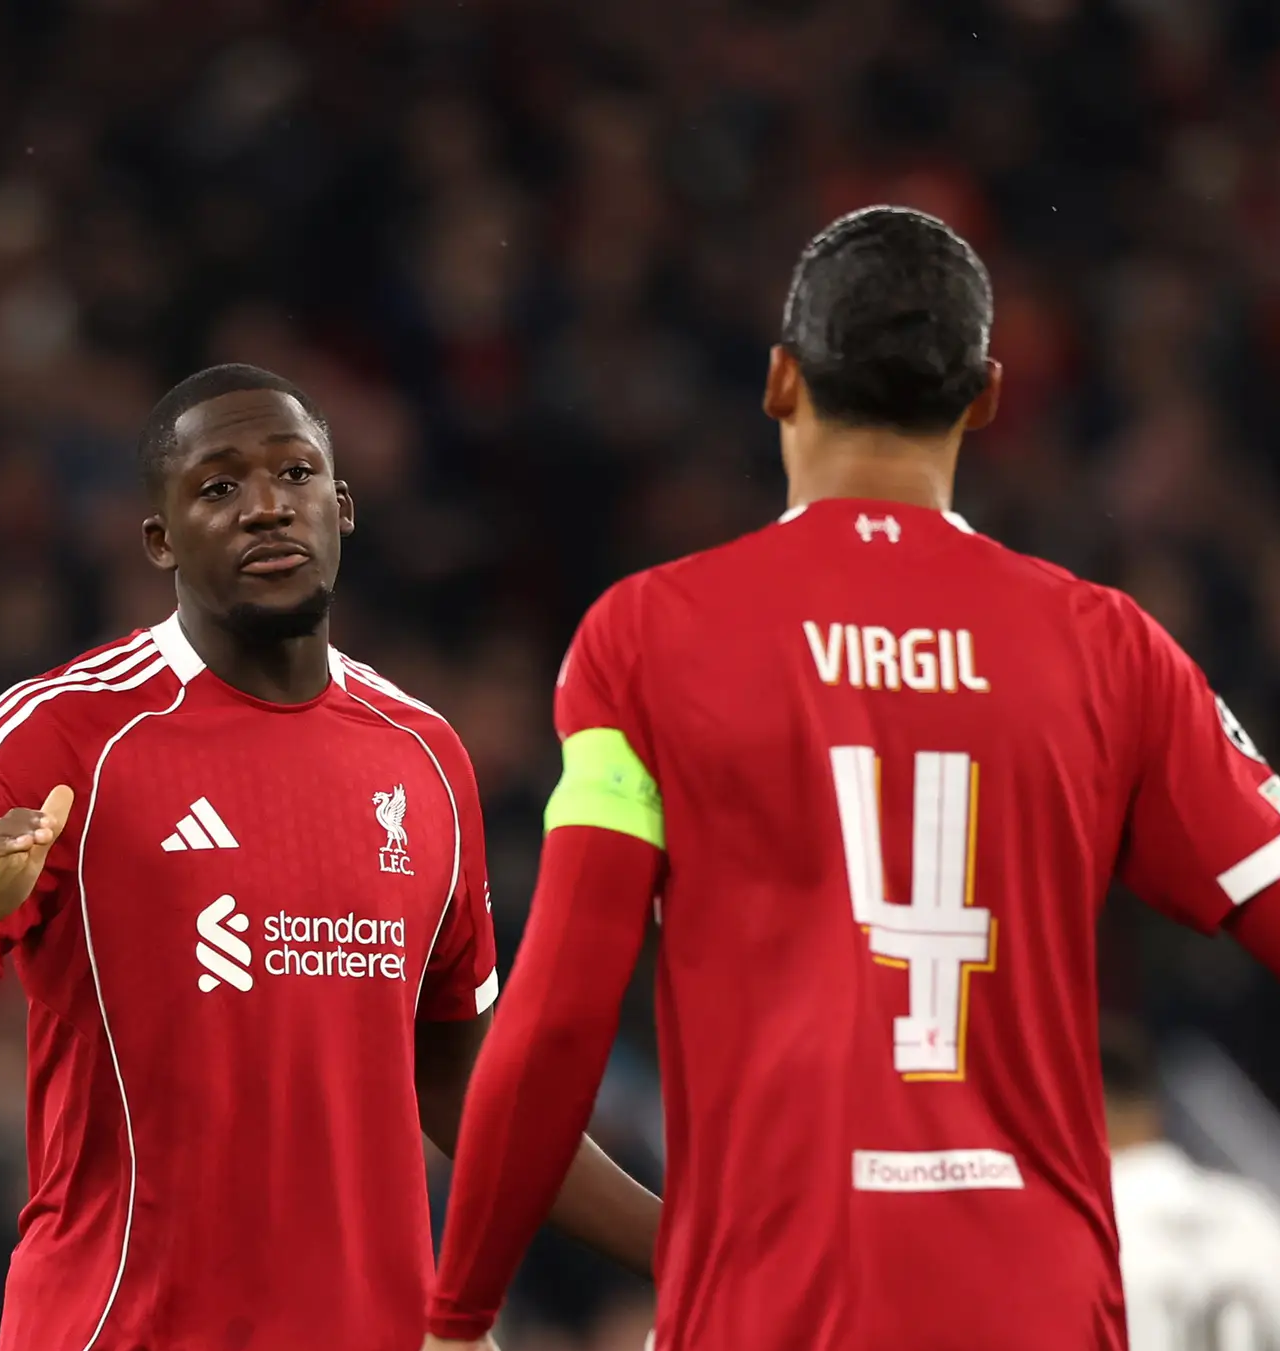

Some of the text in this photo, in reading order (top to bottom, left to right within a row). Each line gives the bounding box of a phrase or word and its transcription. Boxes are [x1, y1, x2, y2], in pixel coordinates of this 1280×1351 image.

[802, 620, 990, 693] VIRGIL
[263, 909, 405, 948] standard
[830, 746, 996, 1081] 4
